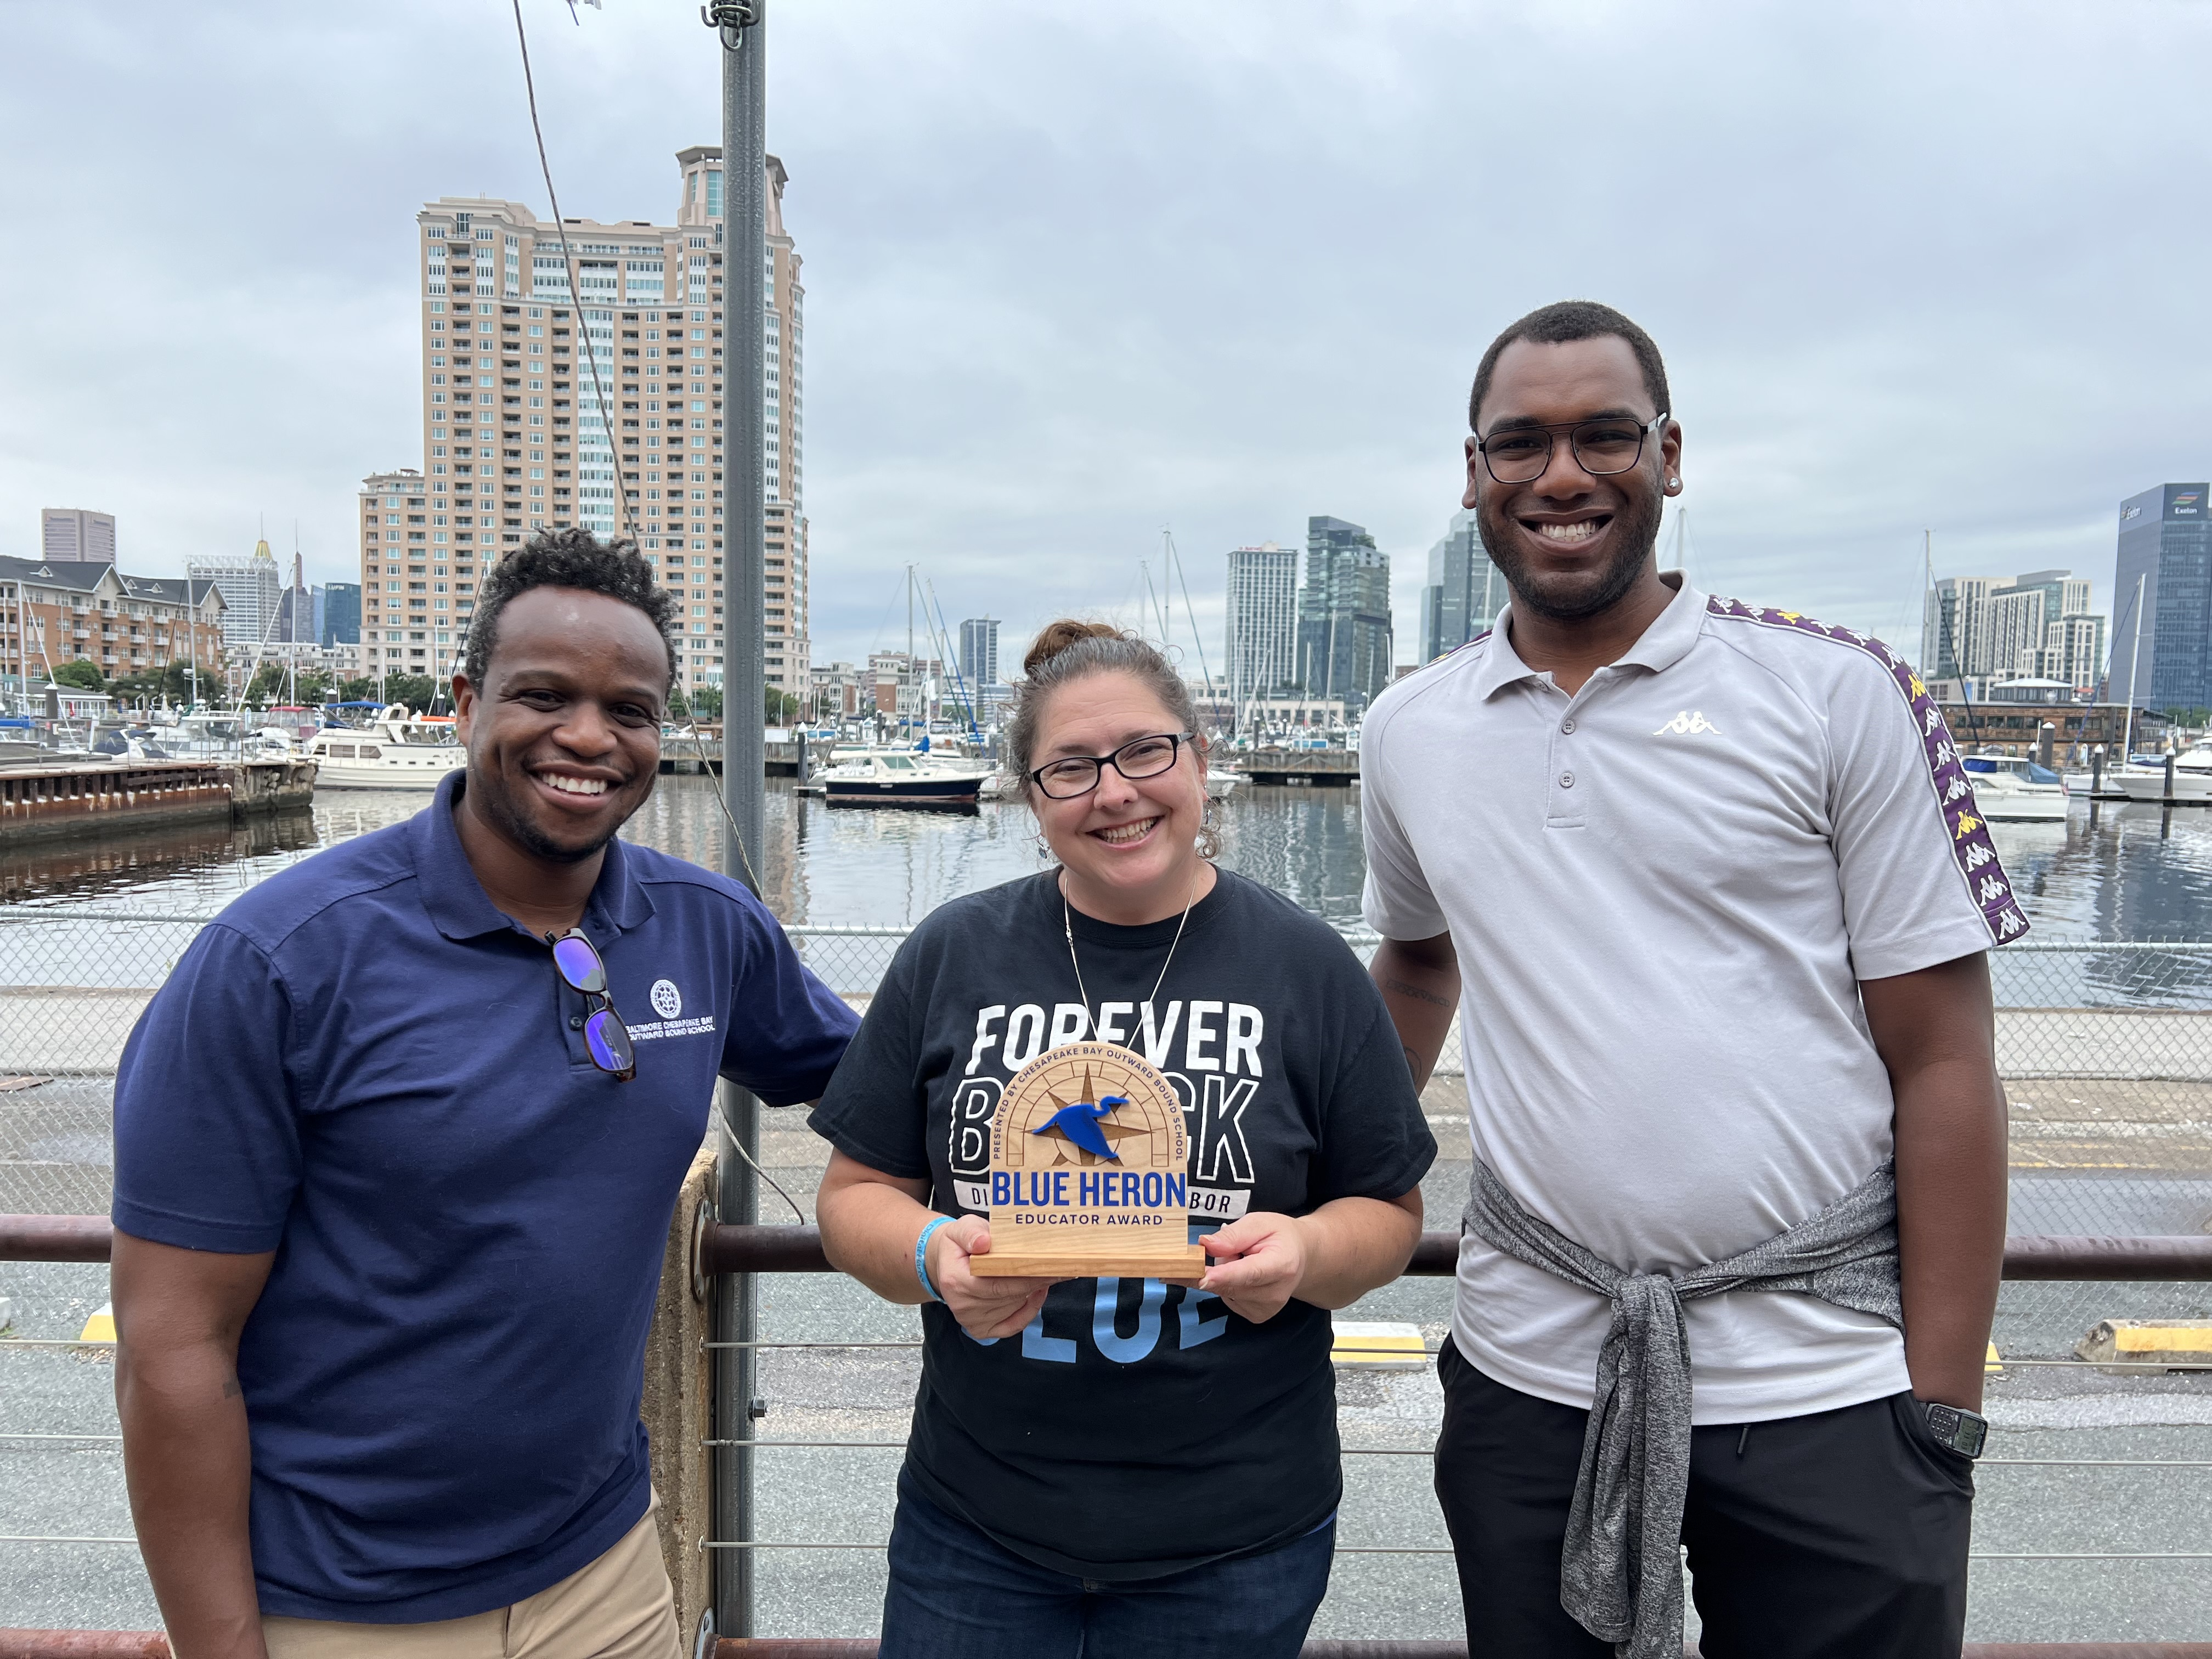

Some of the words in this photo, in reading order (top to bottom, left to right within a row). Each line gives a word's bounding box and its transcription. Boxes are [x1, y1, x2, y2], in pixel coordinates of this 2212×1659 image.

[663, 1018, 701, 1030] CHESAPEAKE
[701, 1015, 713, 1025] BAY
[665, 1028, 687, 1037] BOUND
[687, 1024, 715, 1035] SCHOOL
[994, 1099, 1009, 1159] PRESENTED
[1007, 1083, 1018, 1097] BY
[1018, 1047, 1079, 1082] CHESAPEAKE
[1107, 1049, 1153, 1079] OUTWARD
[1154, 1079, 1177, 1114] BOUND
[1173, 1117, 1183, 1161] SCHOOL
[992, 1171, 1070, 1206] BLUE
[1080, 1171, 1186, 1207] HERON
[1189, 1192, 1231, 1214] BOR
[1015, 1214, 1099, 1224] EDUCATOR
[1107, 1215, 1163, 1225] AWARD
